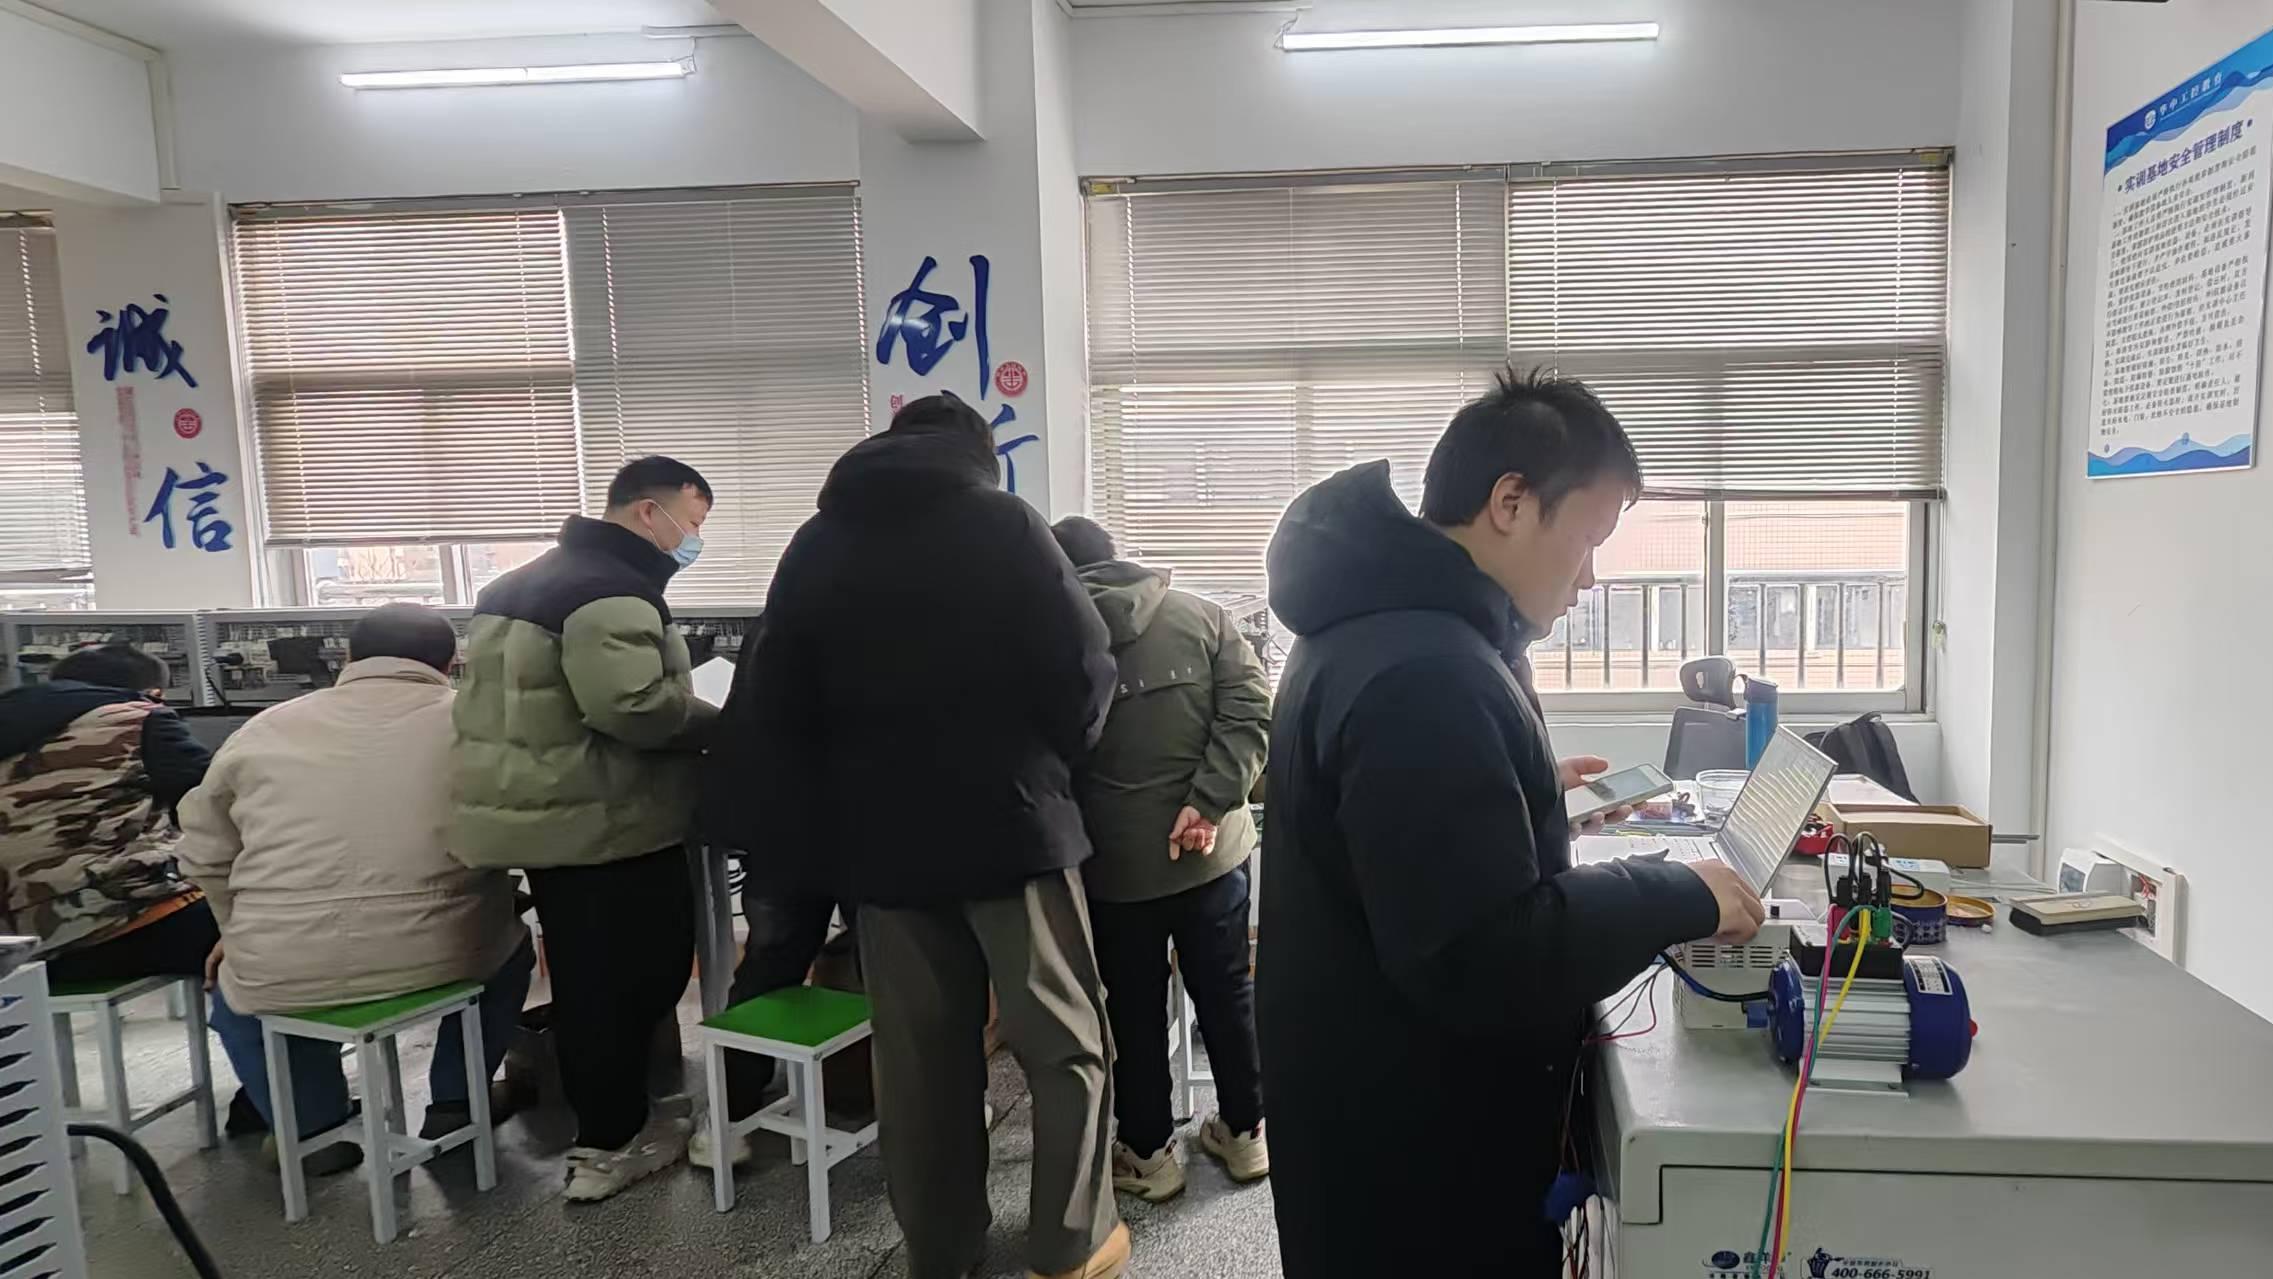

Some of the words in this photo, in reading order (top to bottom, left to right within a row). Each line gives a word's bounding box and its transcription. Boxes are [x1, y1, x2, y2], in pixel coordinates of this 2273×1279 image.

[2124, 119, 2244, 194] 实训基地安全管理制度
